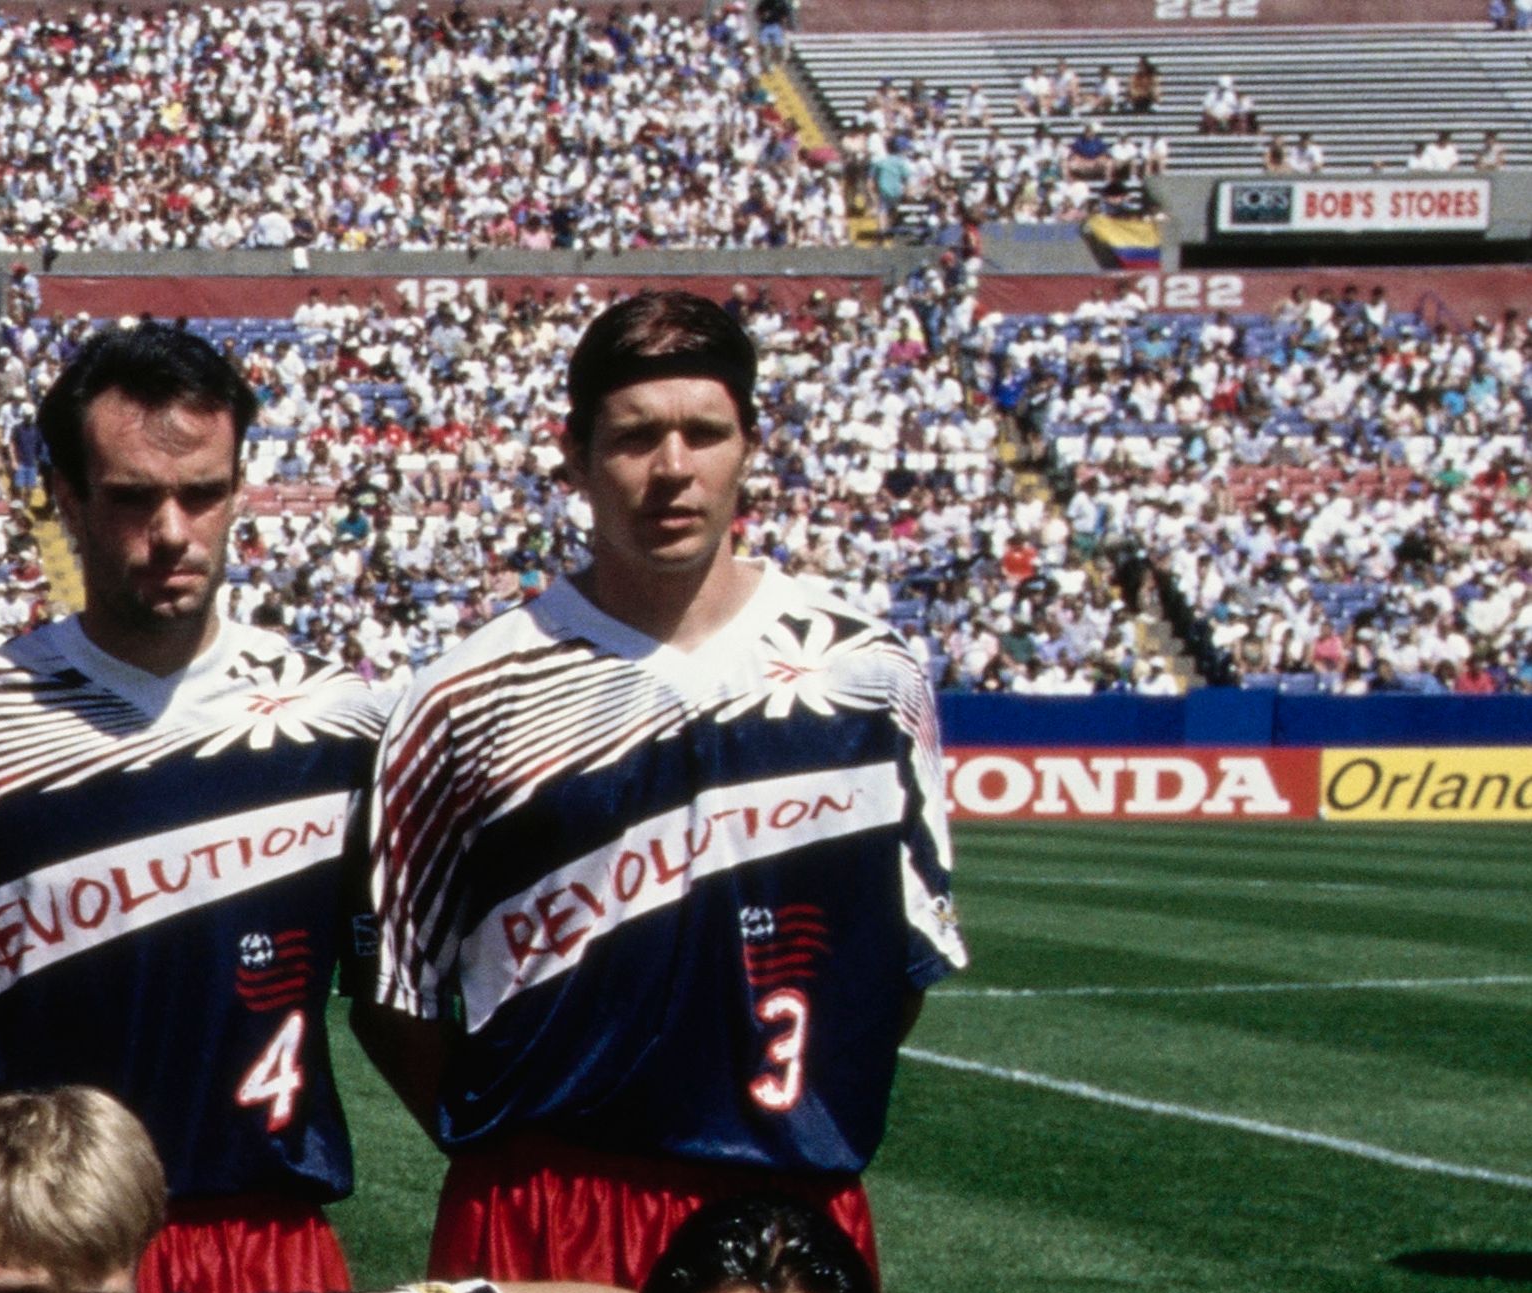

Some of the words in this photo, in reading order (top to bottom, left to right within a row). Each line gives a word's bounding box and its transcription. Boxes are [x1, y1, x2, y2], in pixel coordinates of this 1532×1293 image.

[1304, 192, 1374, 219] BOB'S
[1390, 190, 1480, 219] STORES
[1136, 275, 1244, 307] 122
[501, 792, 857, 982] REVOLUTION
[237, 1009, 306, 1133] 4
[749, 987, 811, 1112] 3
